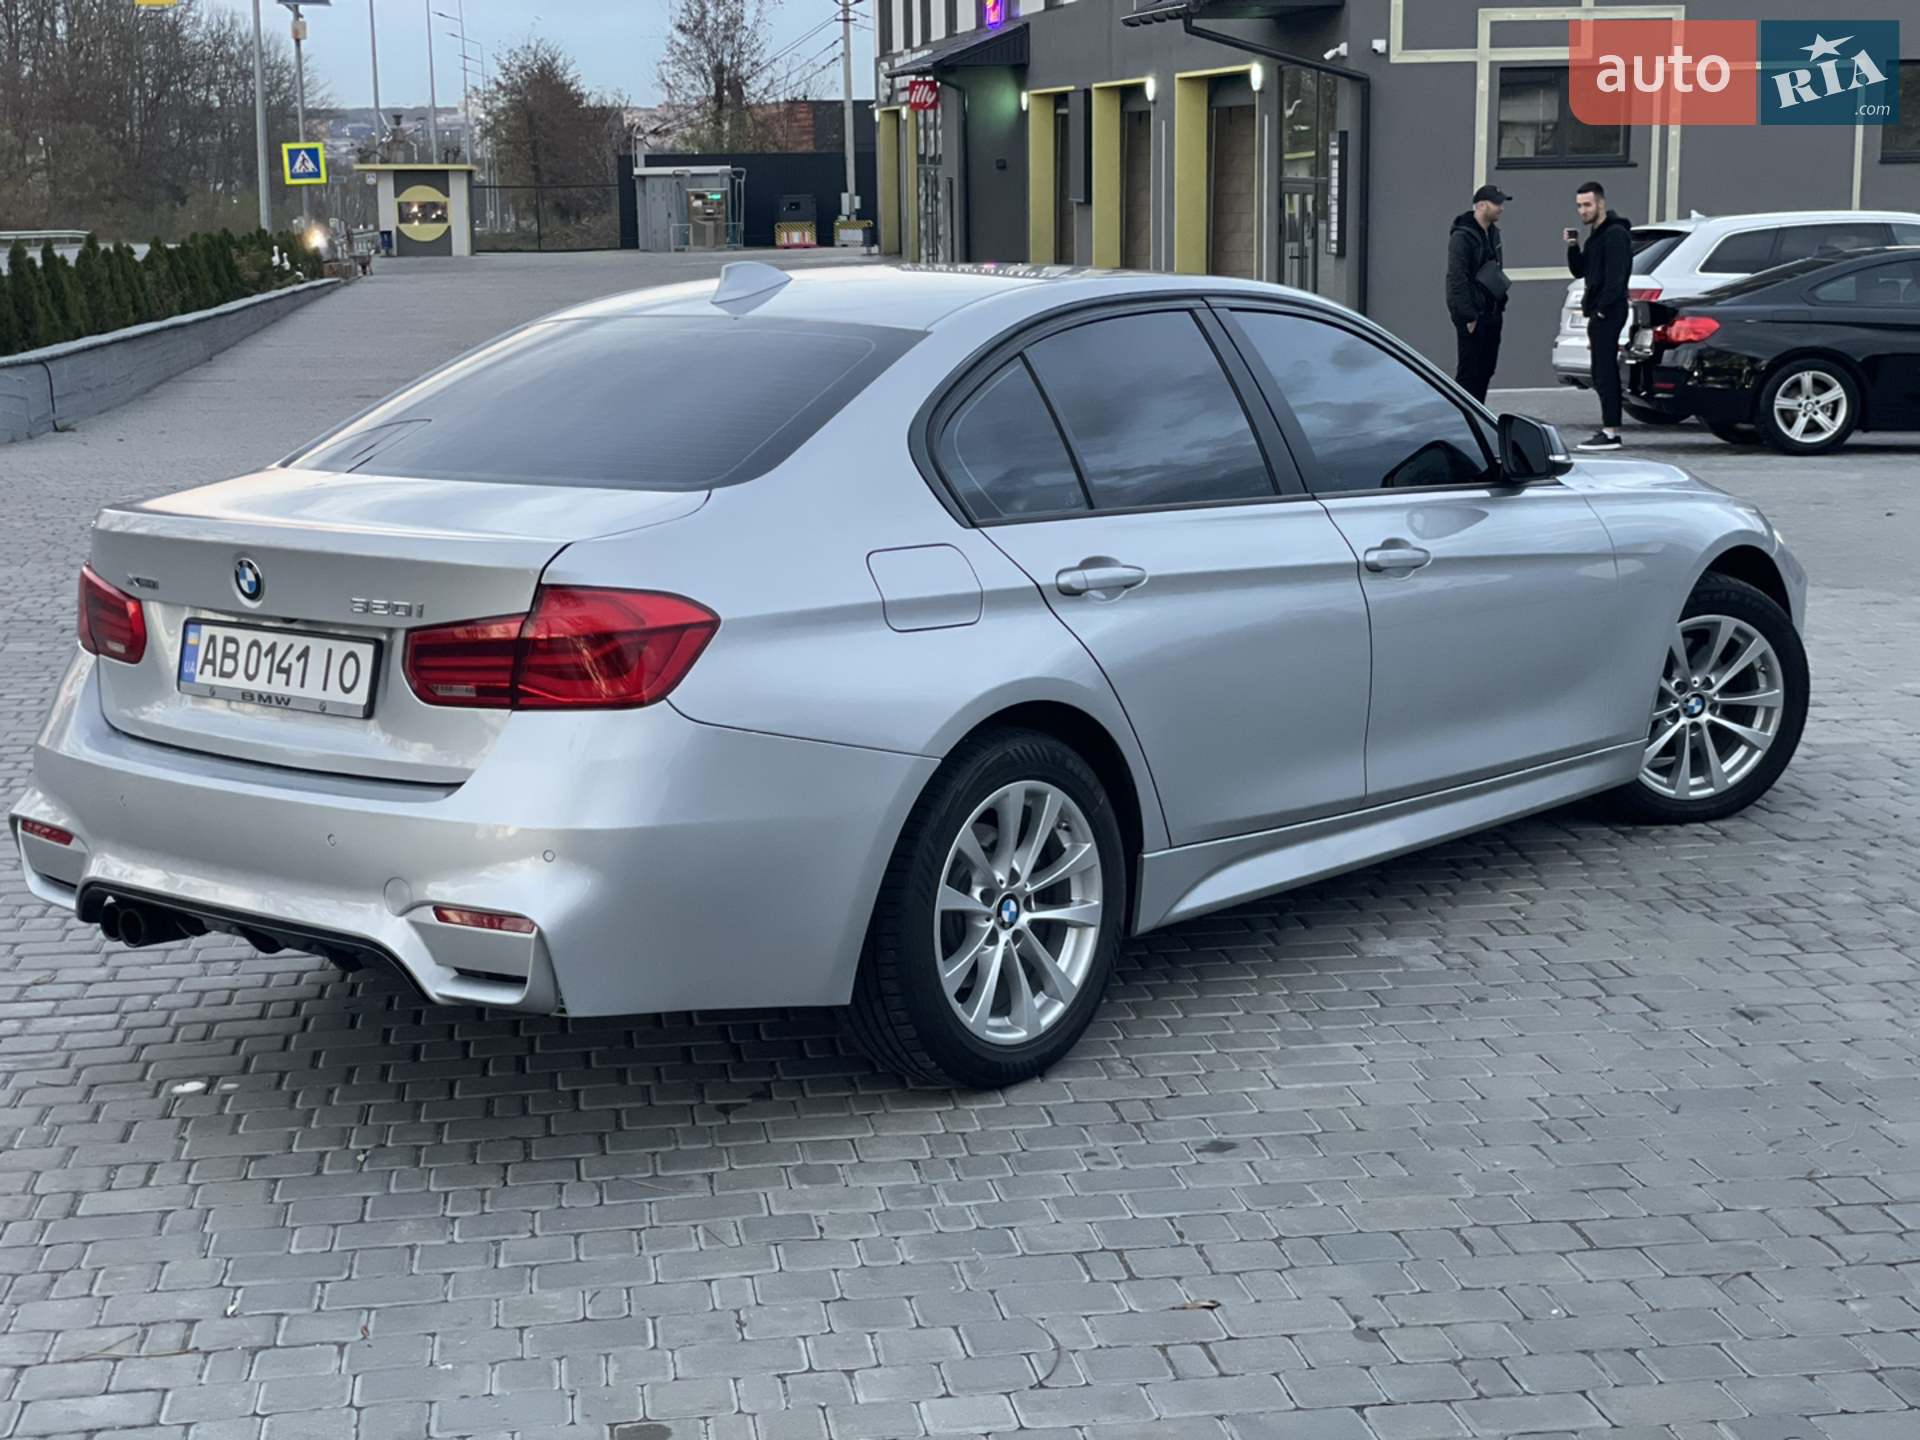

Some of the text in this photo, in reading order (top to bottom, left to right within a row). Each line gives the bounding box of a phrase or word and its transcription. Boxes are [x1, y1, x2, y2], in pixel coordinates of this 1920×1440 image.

[910, 84, 937, 108] illy
[183, 660, 196, 674] UA
[241, 691, 292, 706] BMW
